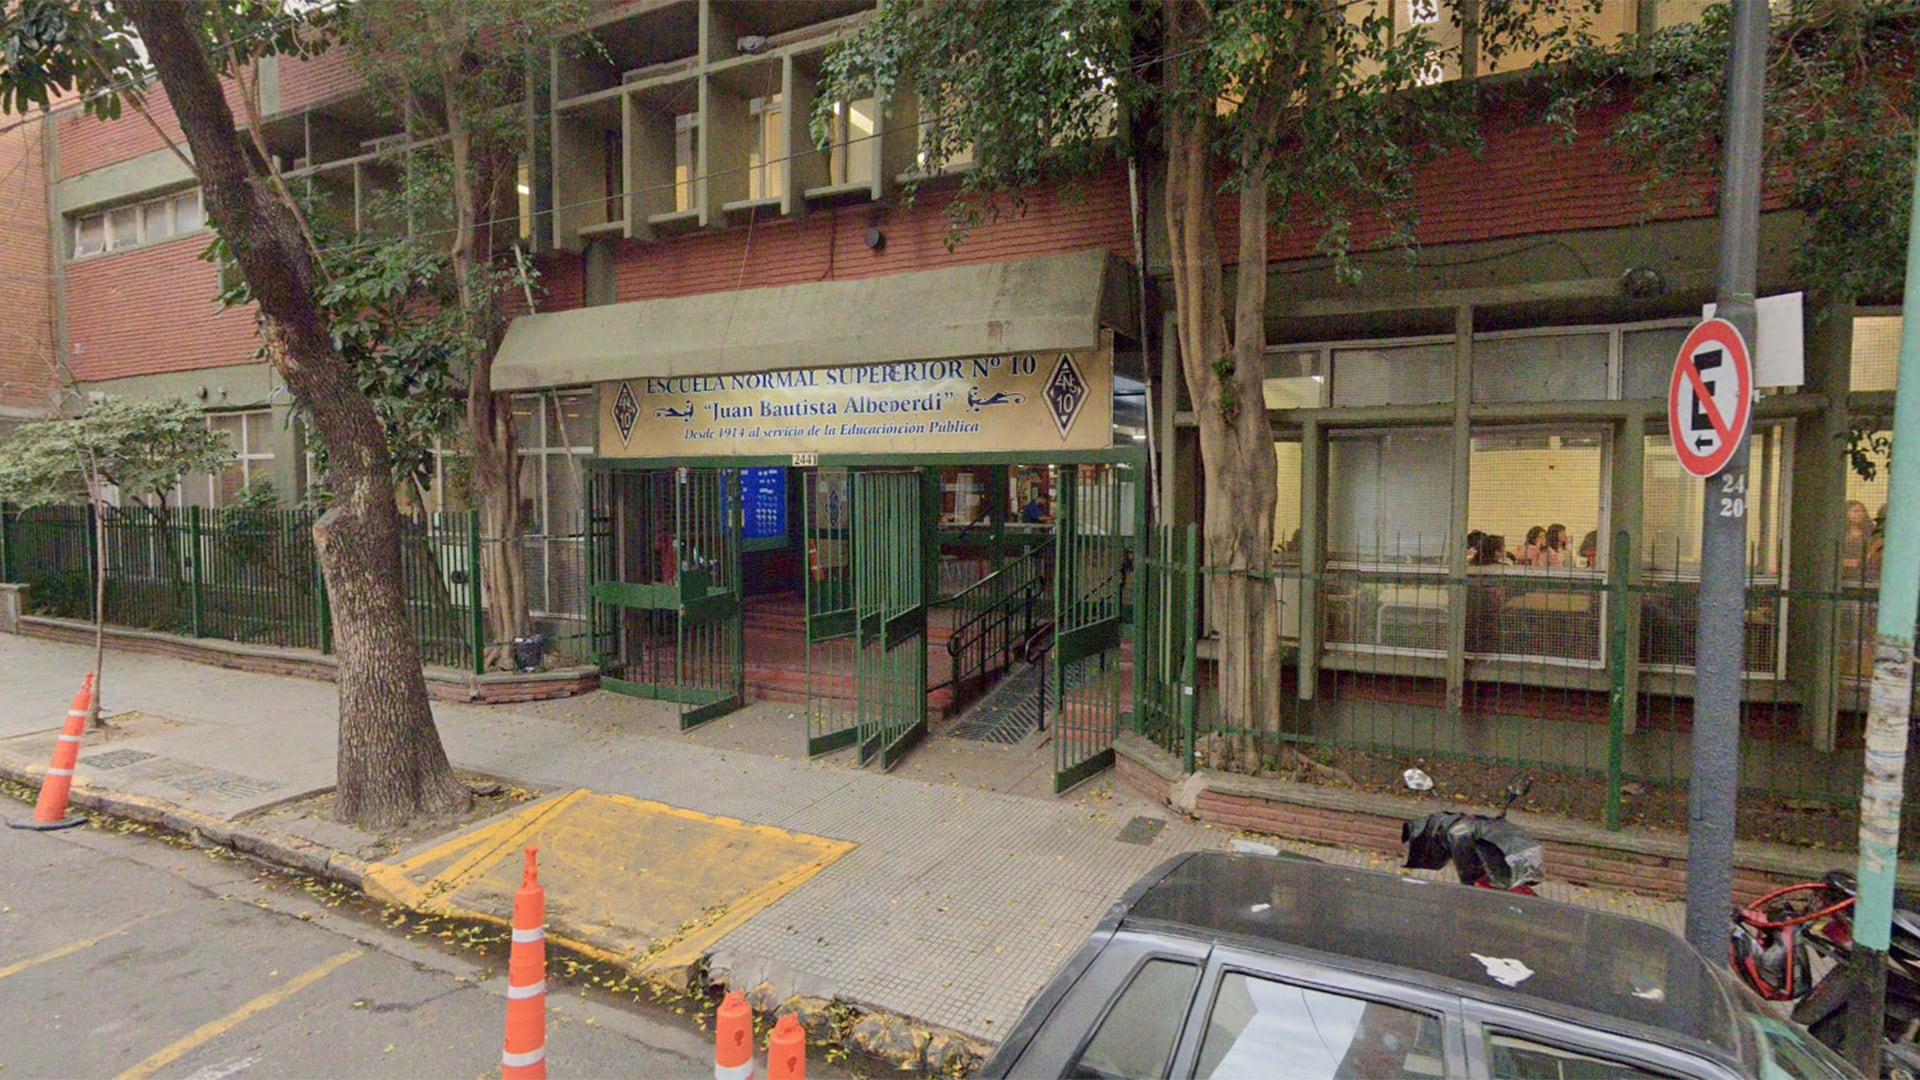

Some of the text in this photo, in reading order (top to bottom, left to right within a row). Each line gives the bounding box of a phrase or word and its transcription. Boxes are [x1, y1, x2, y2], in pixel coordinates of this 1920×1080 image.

[647, 376, 726, 394] ESCUELA
[731, 369, 819, 390] NORMAL
[1011, 355, 1036, 375] 10
[1691, 349, 1723, 431] E
[760, 398, 838, 418] Bautista
[1056, 393, 1074, 413] 10
[620, 412, 631, 429] 10
[685, 428, 714, 440] Desde
[718, 427, 745, 439] 1914
[748, 426, 760, 438] al
[763, 425, 804, 438] servicio
[807, 425, 821, 437] de
[824, 424, 836, 436] la
[929, 420, 979, 434] Pública
[794, 454, 817, 465] 2441
[1721, 473, 1744, 493] 24
[1719, 498, 1744, 518] 20
